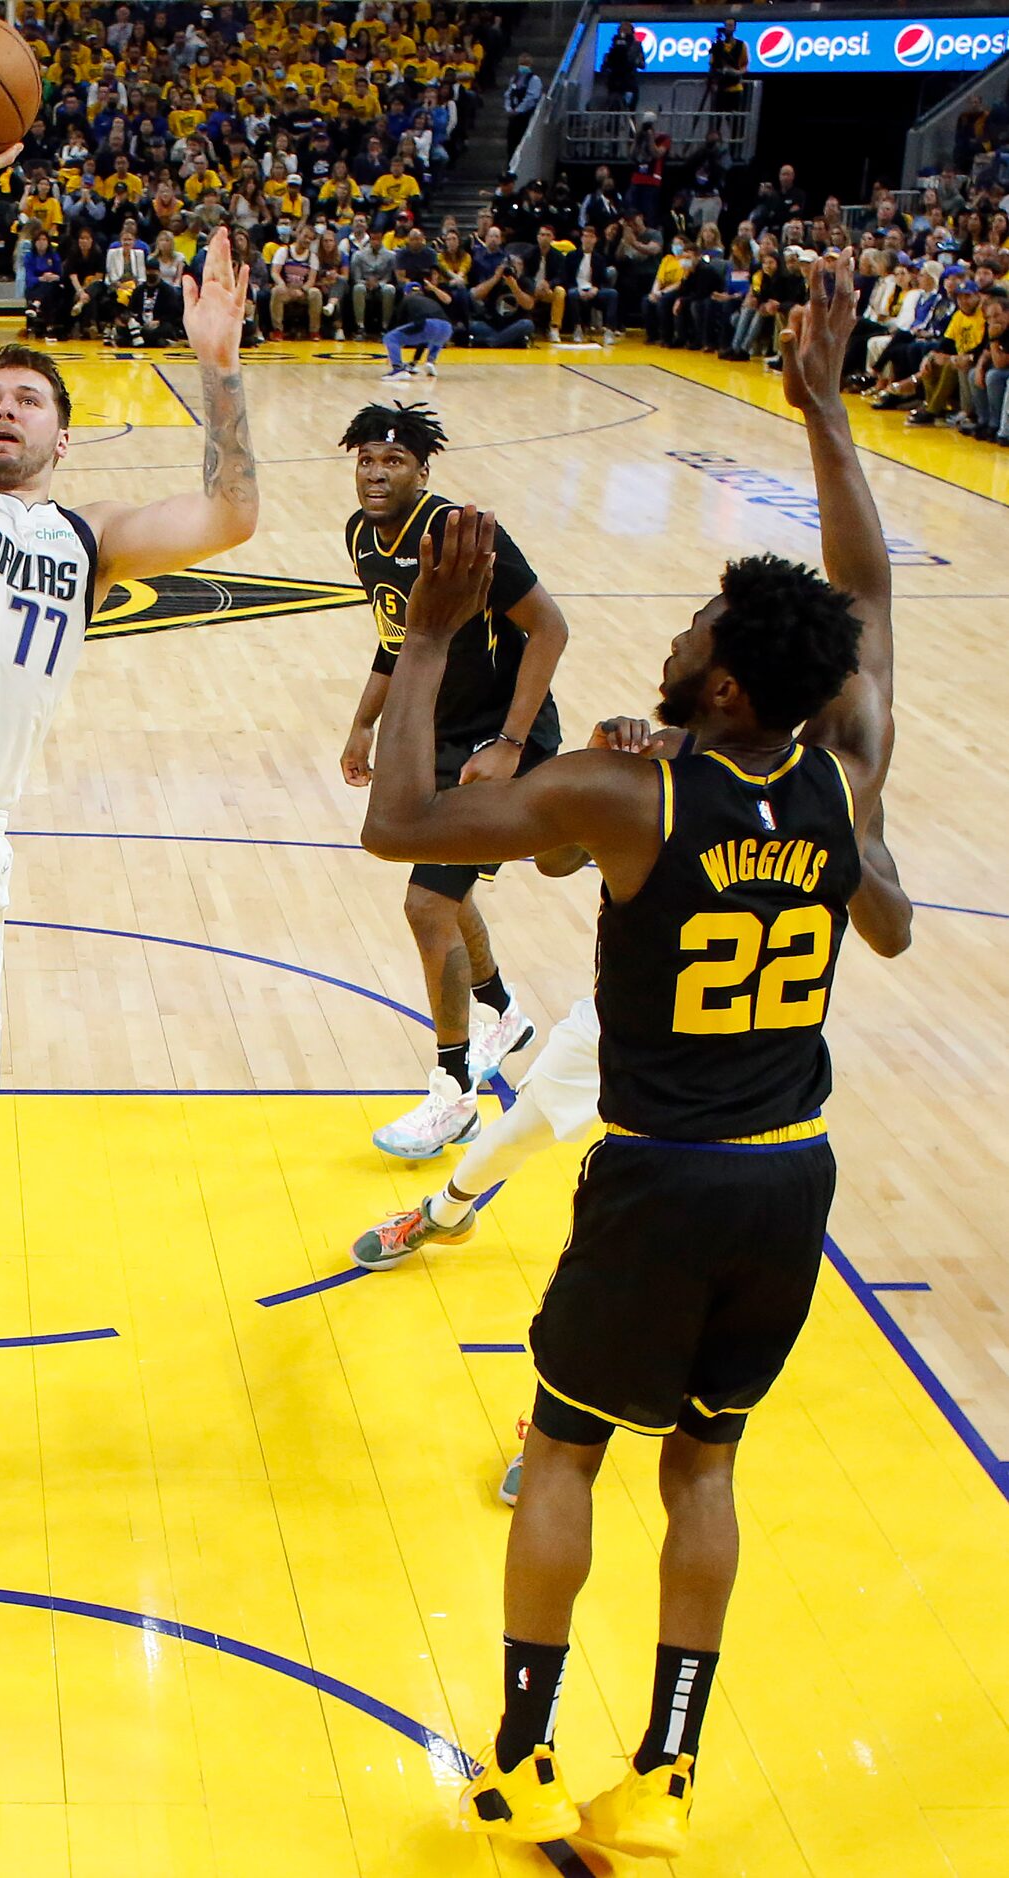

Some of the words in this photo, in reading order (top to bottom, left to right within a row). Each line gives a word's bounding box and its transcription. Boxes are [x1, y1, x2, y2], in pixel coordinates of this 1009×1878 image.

[795, 31, 870, 62] pepsi
[35, 528, 75, 541] chime
[385, 593, 397, 615] 5
[9, 595, 68, 678] 77
[699, 838, 828, 893] WIGGINS
[672, 904, 832, 1035] 22
